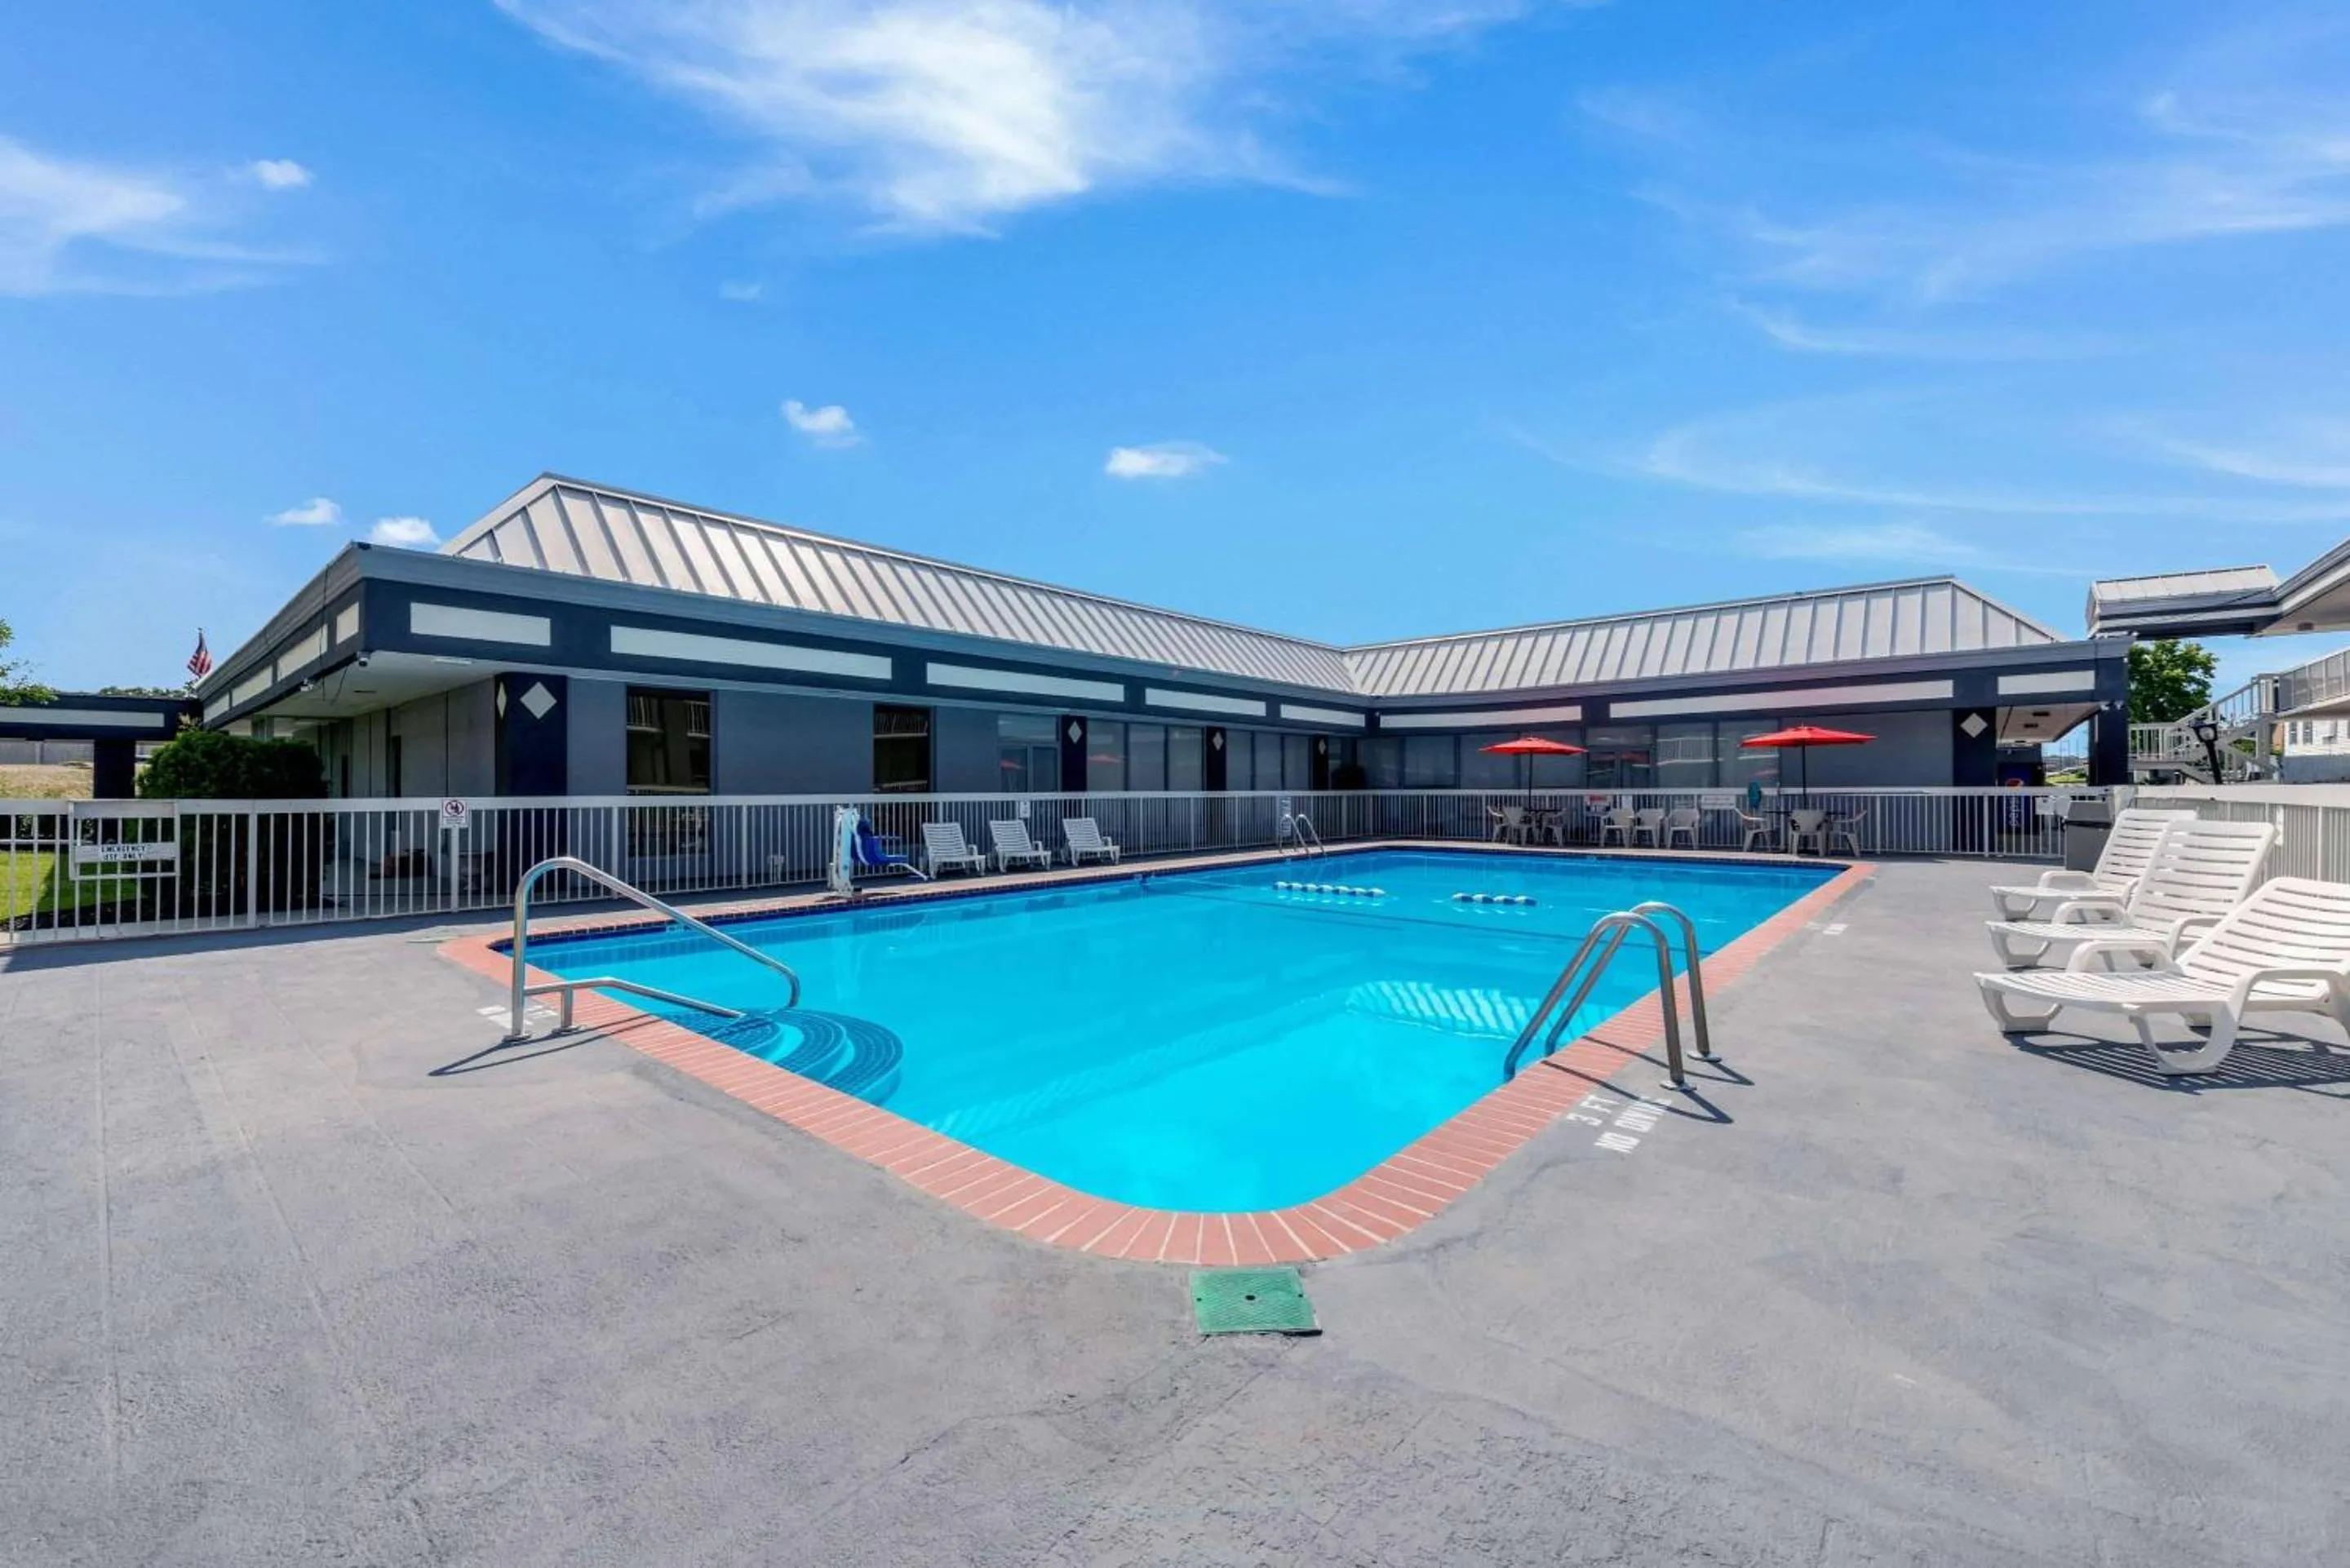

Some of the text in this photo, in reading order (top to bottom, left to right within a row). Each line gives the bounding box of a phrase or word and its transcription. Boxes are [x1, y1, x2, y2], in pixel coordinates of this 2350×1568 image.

[1566, 1094, 1620, 1127] 3 FT
[1594, 1096, 1672, 1154] NO DIVING
